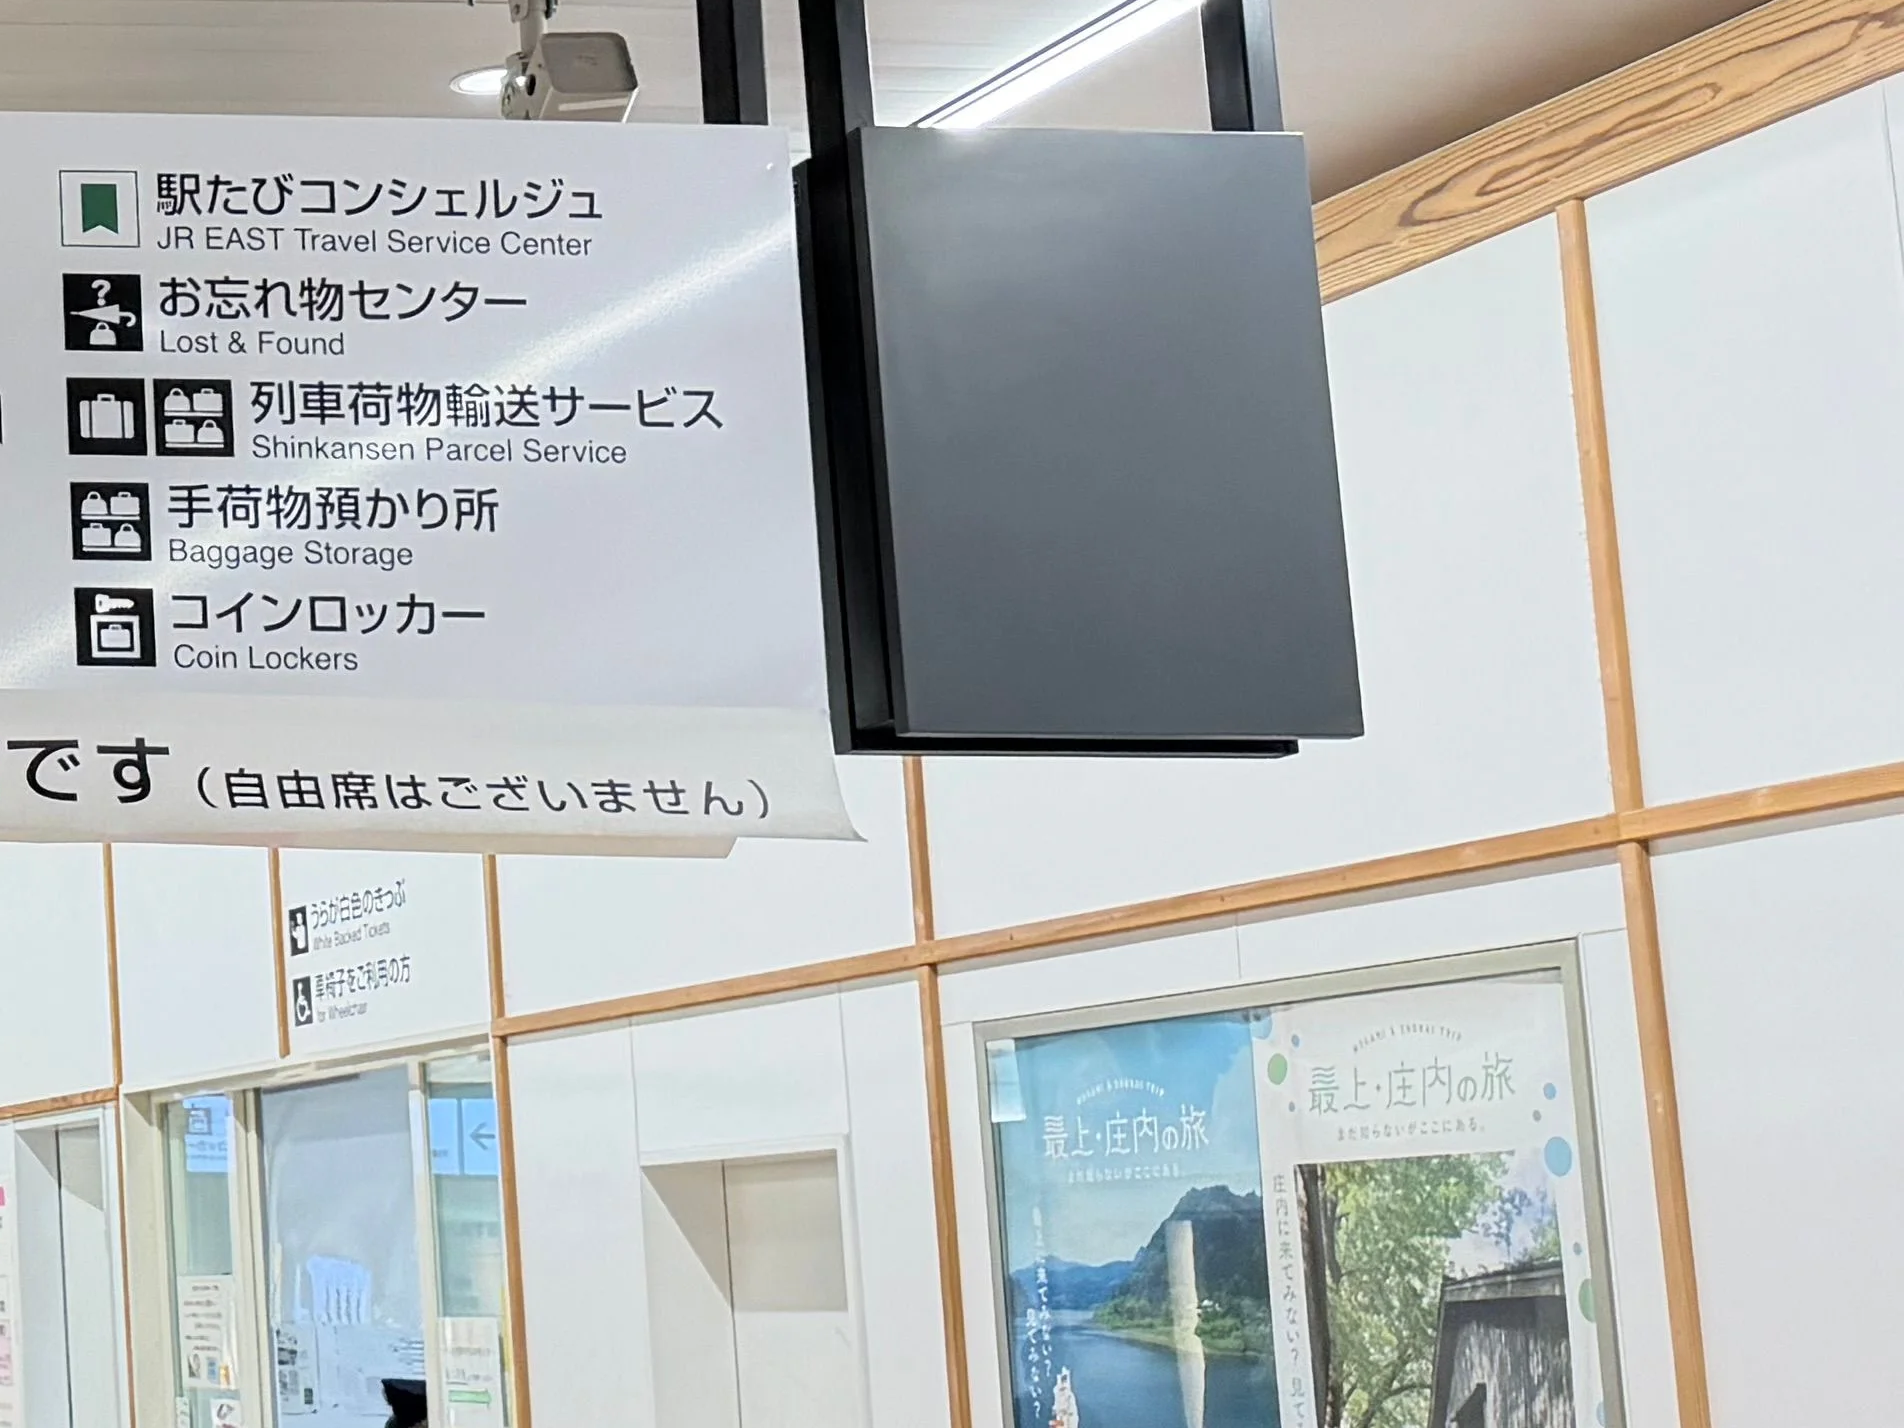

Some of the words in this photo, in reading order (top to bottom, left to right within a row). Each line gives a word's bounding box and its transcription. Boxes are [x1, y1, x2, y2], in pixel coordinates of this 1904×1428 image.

[157, 173, 602, 219] 駅たびコンシェルジュ
[157, 226, 194, 249] JR
[206, 227, 284, 251] EAST
[294, 228, 376, 252] Travel
[388, 229, 490, 254] Service
[501, 231, 592, 255] Center
[160, 276, 526, 322] お忘れ物センター
[161, 330, 218, 353] Lost
[228, 331, 246, 354] &
[259, 331, 344, 355] Found
[250, 380, 723, 428] 列車荷物輸送サービス
[252, 434, 414, 460] Shinkansen
[426, 438, 512, 461] Parcel
[524, 439, 626, 463] Service
[168, 484, 498, 532] 手荷物預かり所
[169, 539, 293, 570] Baggage
[305, 540, 412, 571] Storage
[172, 592, 485, 634] コインロッカー
[174, 644, 237, 668] Coin
[249, 646, 357, 670] Lockers
[1308, 1051, 1516, 1116] 最上・庄内の旅
[1042, 1103, 1209, 1160] 最上・庄内の旅
